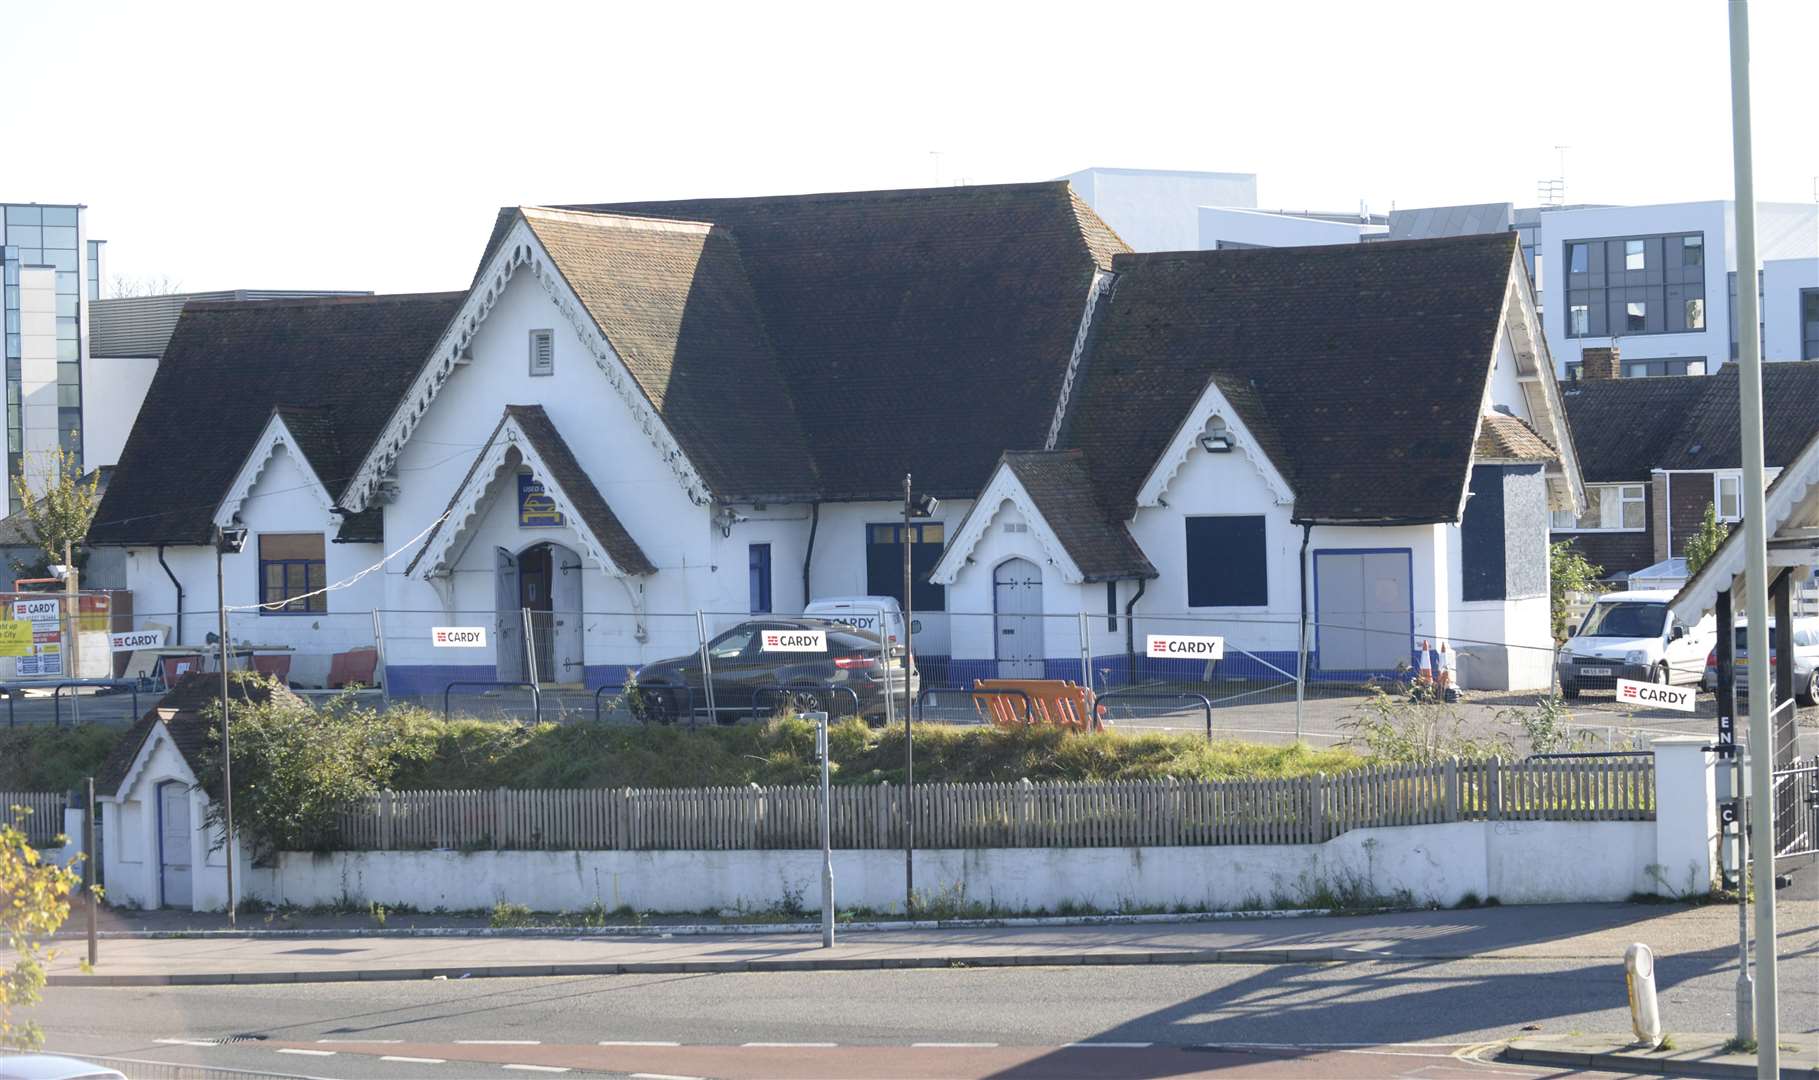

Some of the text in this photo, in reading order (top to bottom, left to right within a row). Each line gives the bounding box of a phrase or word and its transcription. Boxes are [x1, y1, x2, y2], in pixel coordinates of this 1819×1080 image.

[28, 603, 55, 614] CARDY
[124, 634, 158, 646] CARDY
[447, 632, 480, 642] CARDY
[780, 635, 819, 646] CARDY
[1168, 641, 1215, 653] CARDY
[1639, 687, 1687, 705] CARDY
